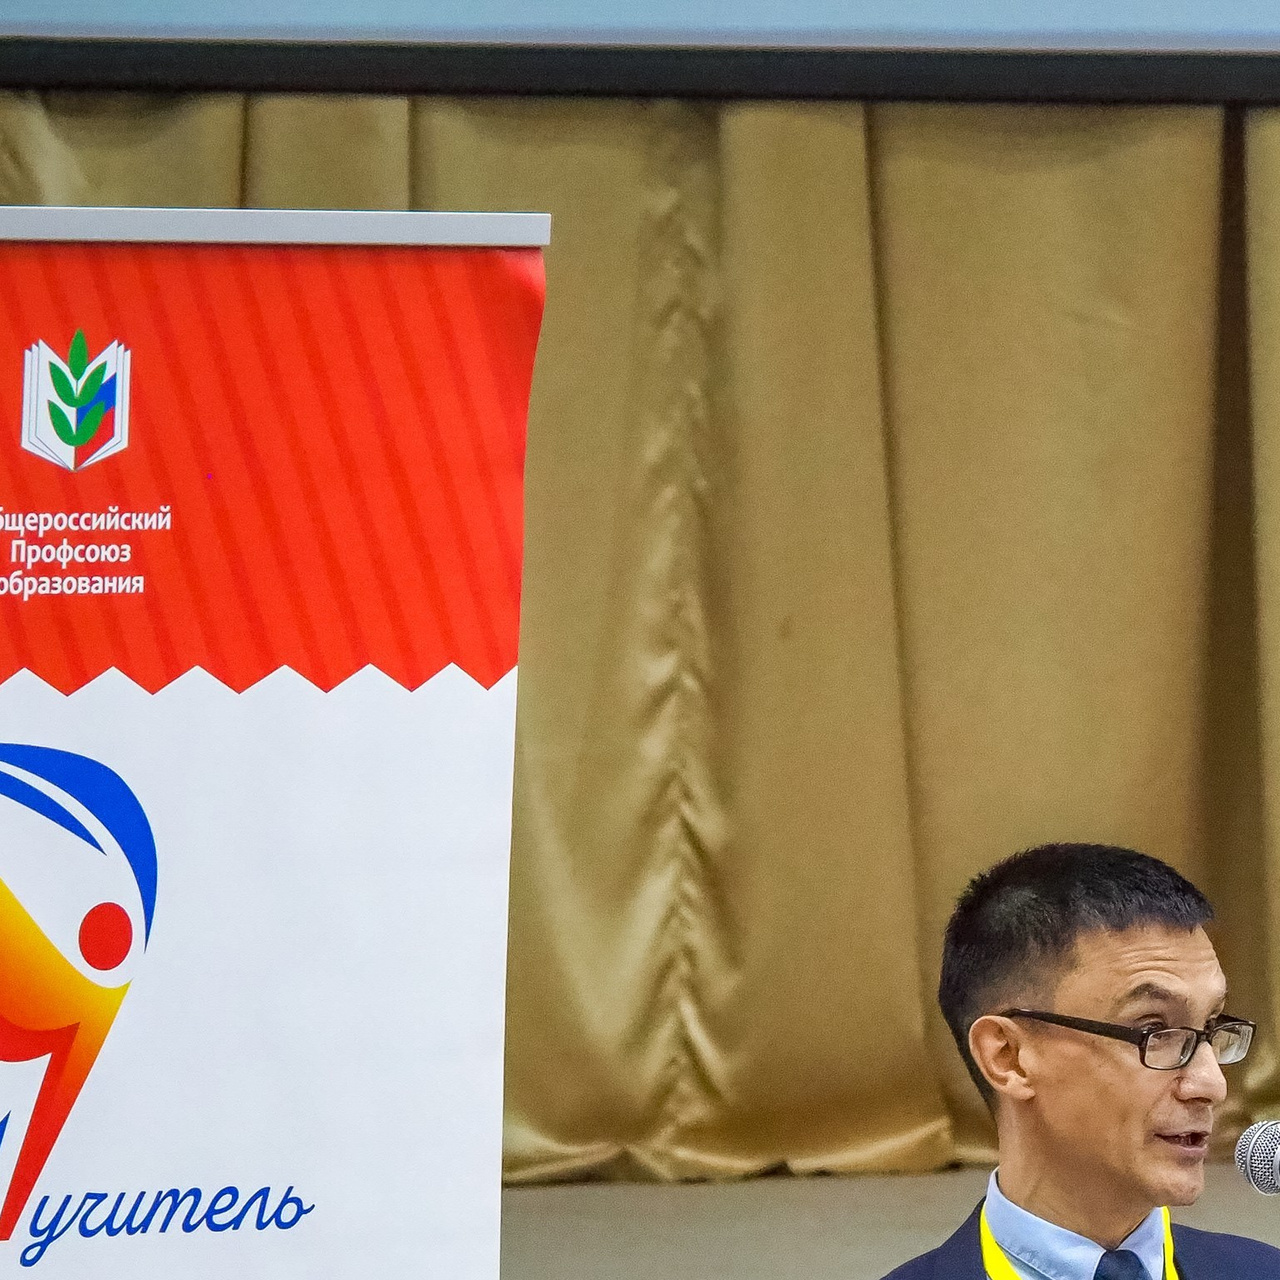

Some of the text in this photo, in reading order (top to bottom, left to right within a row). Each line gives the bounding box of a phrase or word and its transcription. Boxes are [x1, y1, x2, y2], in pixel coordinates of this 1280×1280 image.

[10, 538, 131, 570] Профсоюз
[0, 570, 145, 602] образования
[19, 1185, 316, 1268] учитель
